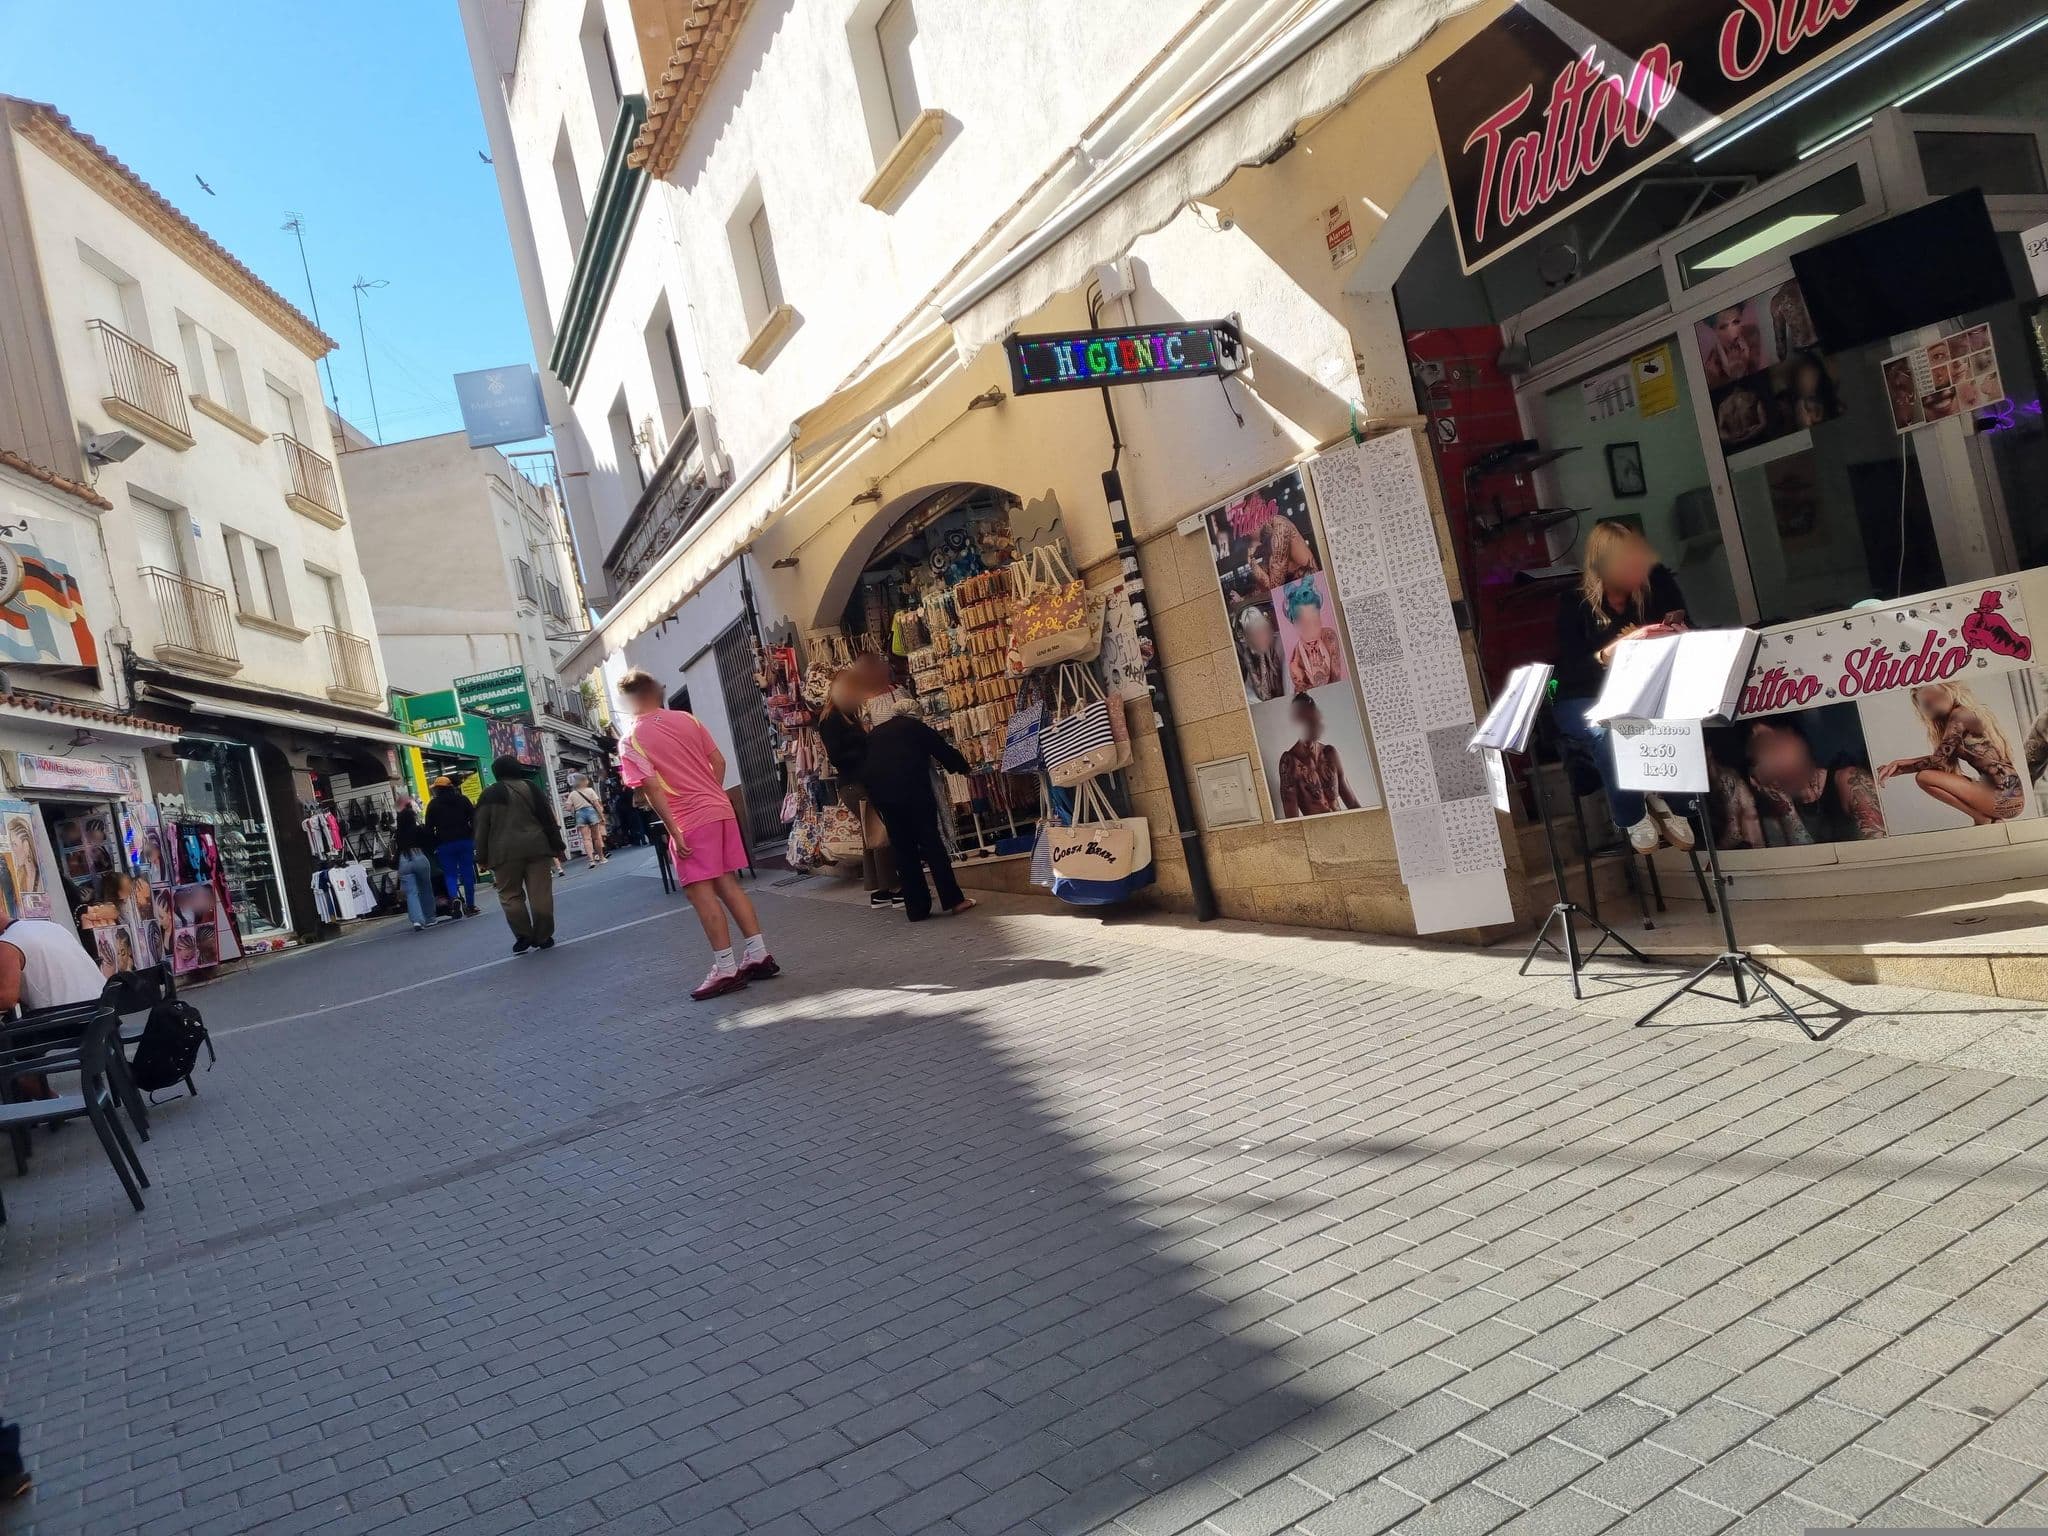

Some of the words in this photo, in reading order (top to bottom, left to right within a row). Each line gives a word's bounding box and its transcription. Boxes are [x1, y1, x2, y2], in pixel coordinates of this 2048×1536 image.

[1463, 42, 1683, 242] Tattoo
[1054, 336, 1185, 376] HIGIENIC
[456, 667, 521, 686] SUPERMERCADO
[1738, 667, 1823, 715] attoo
[1838, 630, 1972, 698] Studio
[460, 675, 522, 694] SUPERMARKET
[460, 682, 525, 704] SUPERMARCHÉ
[496, 705, 510, 713] PER
[433, 719, 447, 727] PER
[447, 716, 458, 724] TU
[1619, 724, 1645, 735] Mini
[1648, 725, 1691, 735] Tattoos
[452, 730, 465, 749] TU
[1640, 743, 1676, 758] 2x60
[1643, 763, 1678, 777] 1x40
